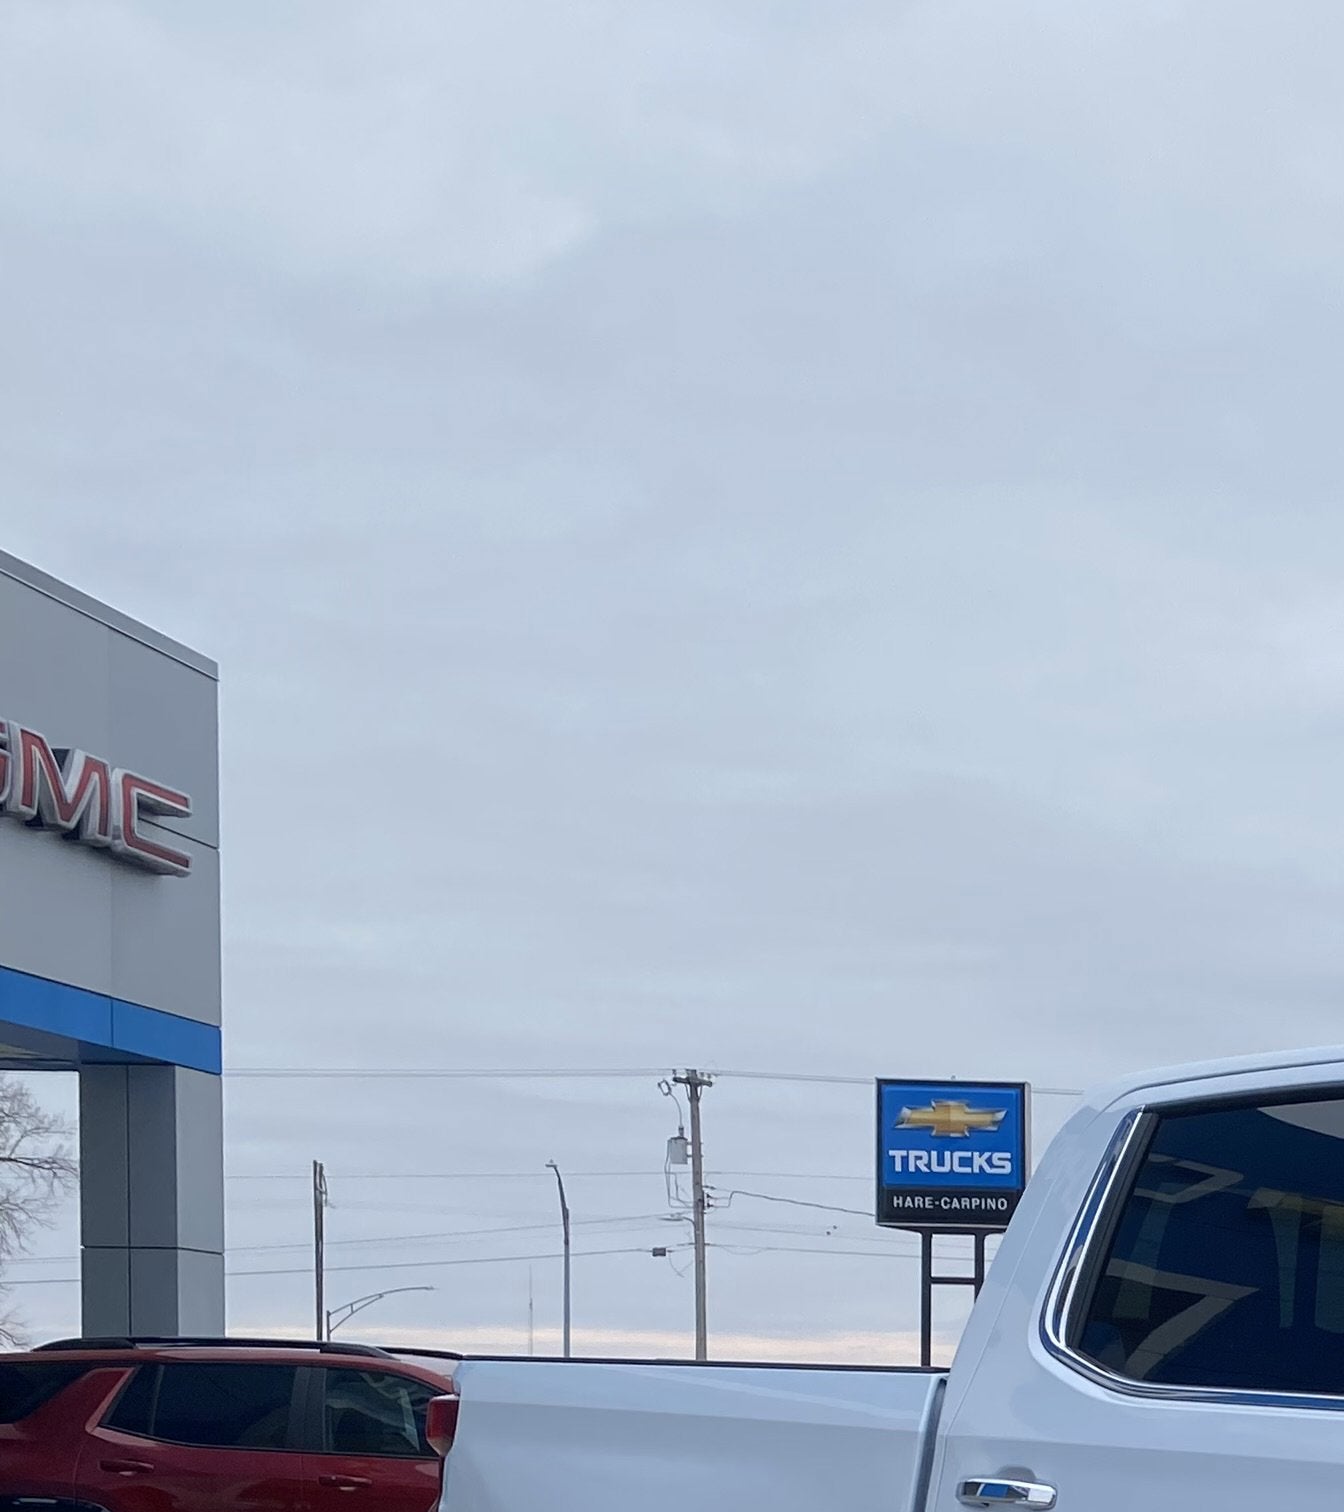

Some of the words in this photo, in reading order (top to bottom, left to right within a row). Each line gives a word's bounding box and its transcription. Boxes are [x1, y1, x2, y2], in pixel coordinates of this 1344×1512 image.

[0, 716, 193, 877] MC
[889, 1149, 1012, 1175] TRUCKS
[893, 1195, 1008, 1211] HARE-CARPINO
